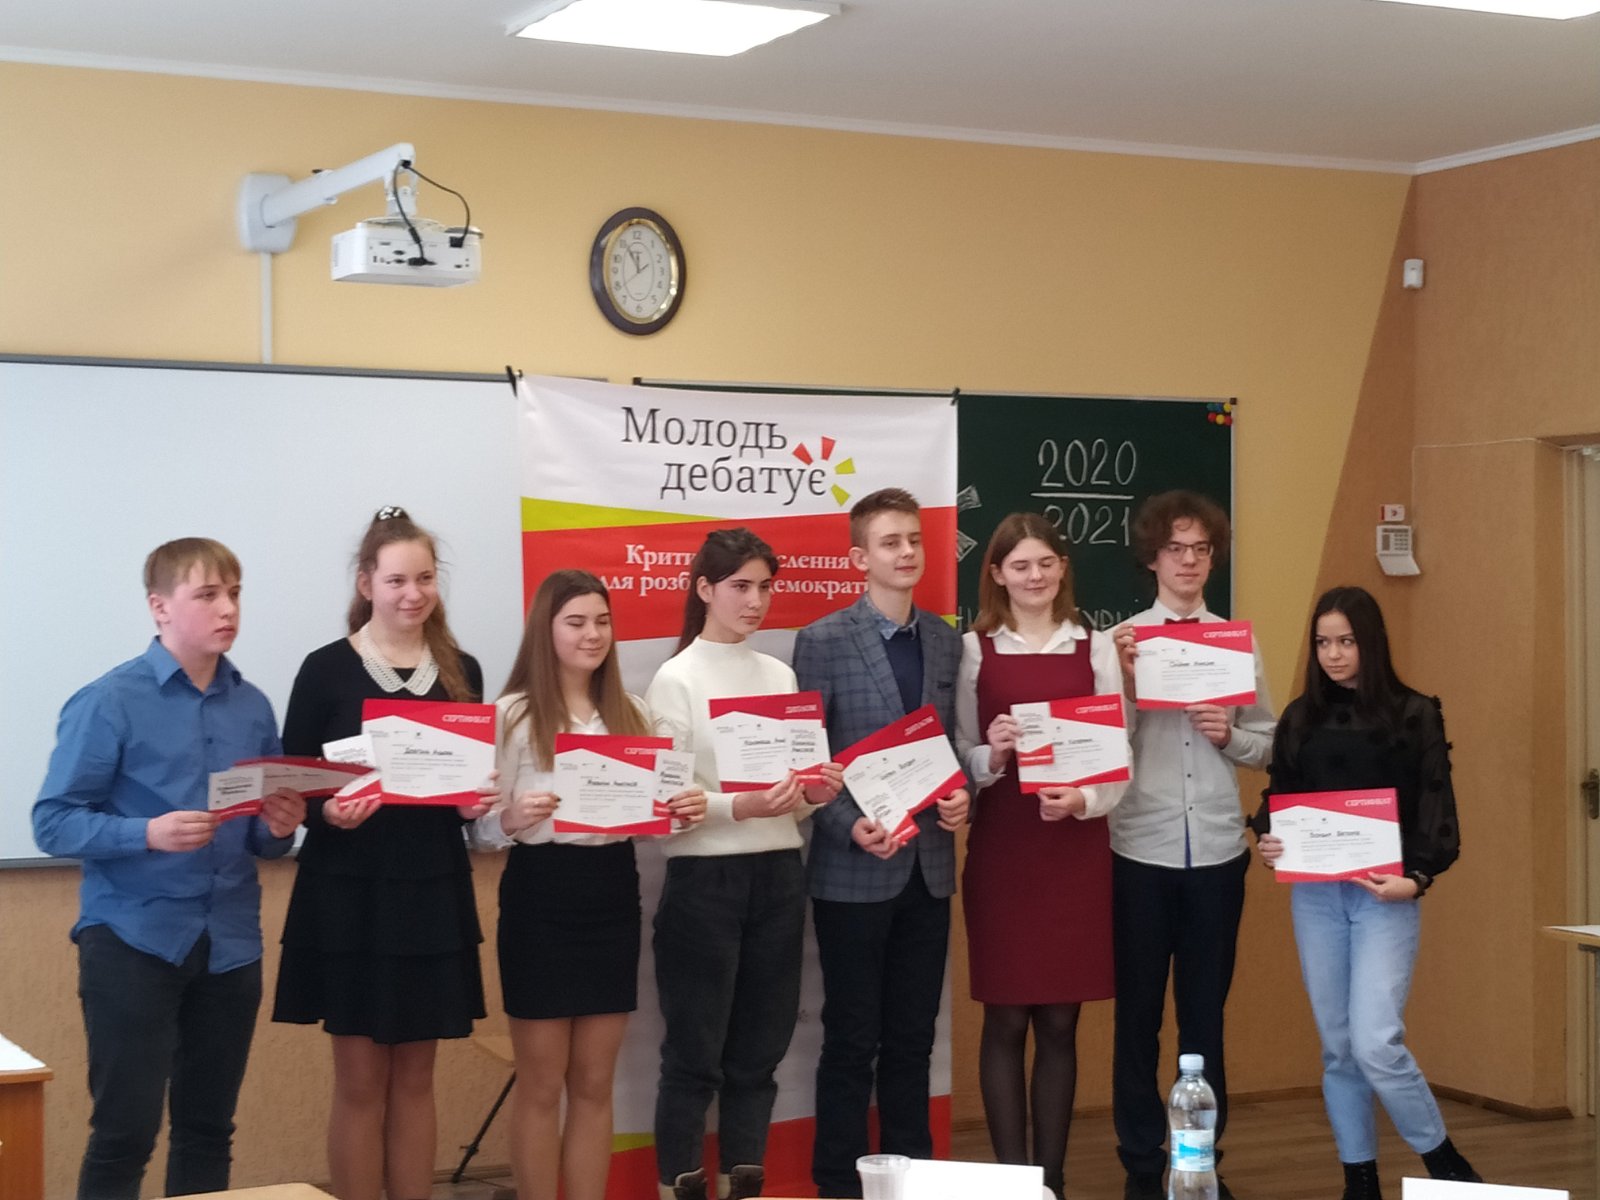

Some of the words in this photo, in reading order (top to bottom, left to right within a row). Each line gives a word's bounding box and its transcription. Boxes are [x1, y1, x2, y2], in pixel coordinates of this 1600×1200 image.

[633, 230, 642, 240] 12
[621, 406, 788, 459] Молодь
[660, 455, 827, 506] дебатує
[1037, 438, 1137, 488] 2020
[1043, 502, 1130, 547] 2021
[625, 543, 697, 572] Крити
[776, 554, 851, 570] слення
